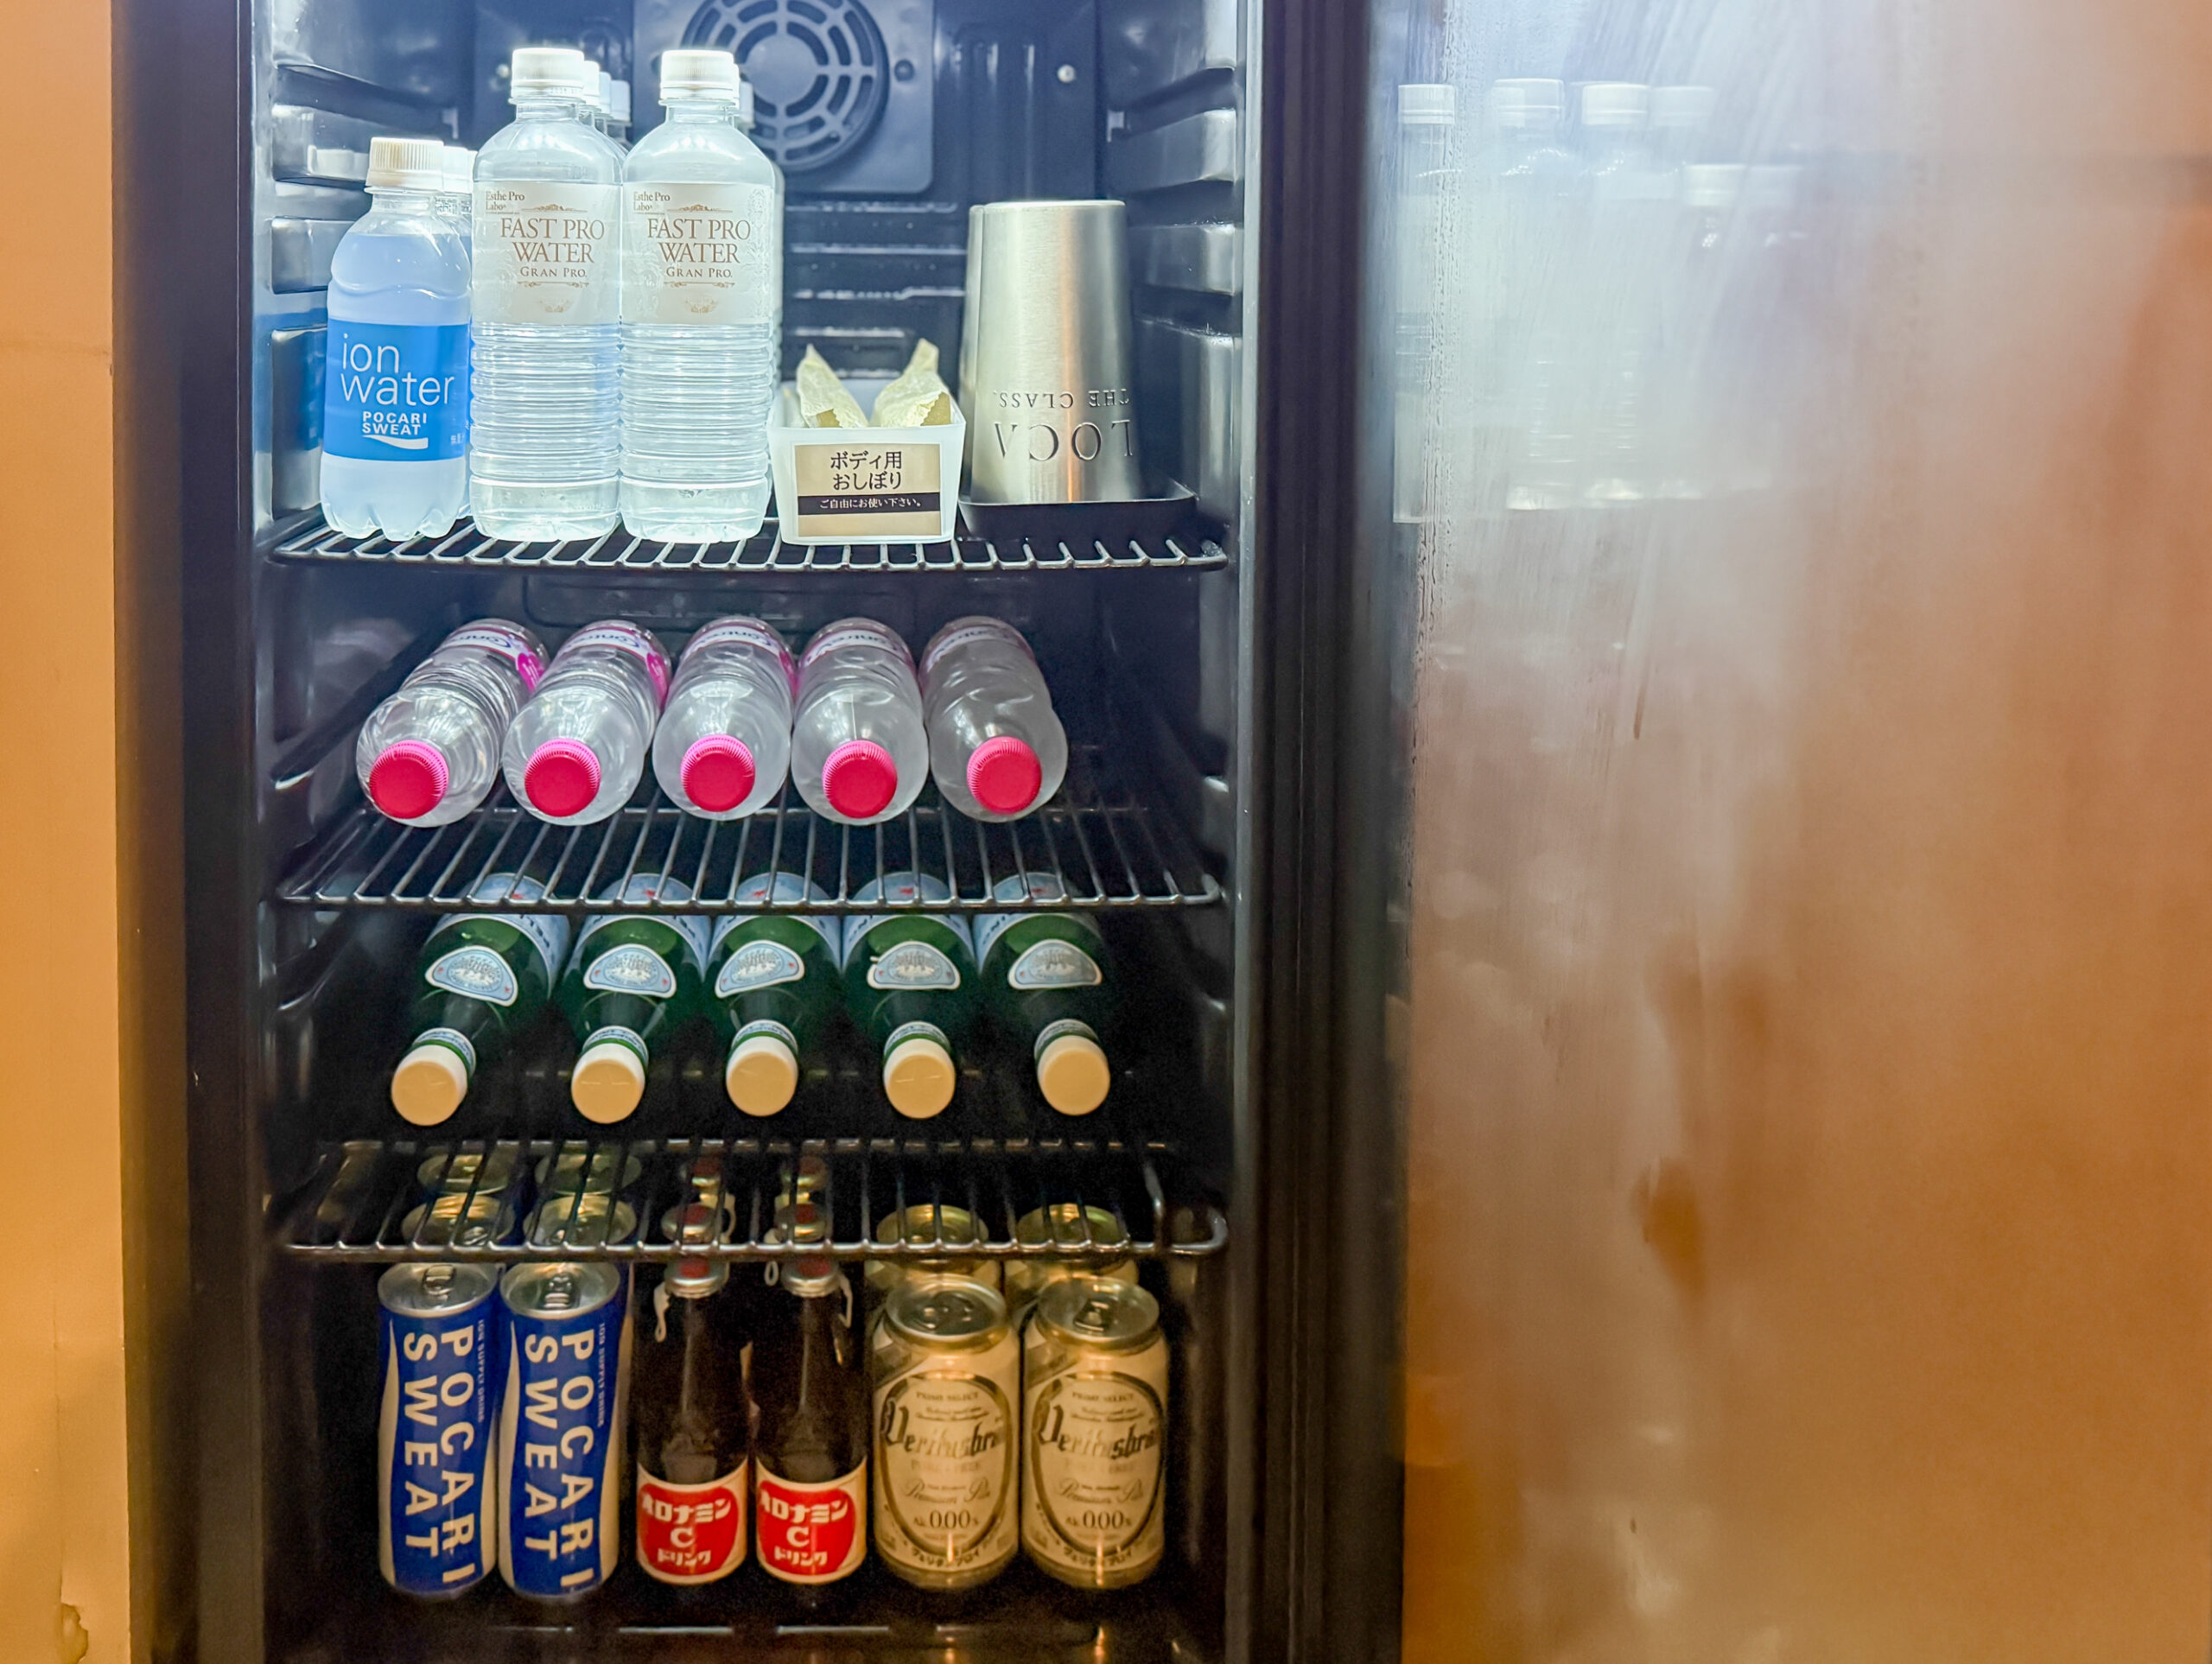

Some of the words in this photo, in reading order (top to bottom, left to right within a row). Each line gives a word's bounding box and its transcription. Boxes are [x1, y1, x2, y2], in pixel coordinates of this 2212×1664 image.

[486, 191, 507, 200] Esthe
[508, 191, 525, 201] Pro
[633, 191, 653, 201] Esthe
[654, 192, 671, 201] Pro
[499, 218, 557, 238] FAST
[563, 219, 605, 240] PRO
[647, 218, 702, 239] FAST
[708, 219, 751, 240] PRO
[512, 242, 594, 264] WATER
[658, 242, 741, 264] WATER
[342, 333, 400, 374] ion
[340, 372, 455, 406] water
[1087, 388, 1130, 407] THE
[362, 410, 428, 424] POCARI
[362, 422, 422, 435] SWEAT
[994, 420, 1134, 461] LOCA
[830, 451, 902, 470] ボディ用
[833, 471, 902, 491] おしぼり
[820, 497, 922, 509] ご自由にお使い下さい。
[404, 1332, 439, 1559] SWEAT
[441, 1325, 475, 1584] POCARI
[524, 1334, 558, 1560] SWEAT
[560, 1330, 594, 1587] POCARI
[671, 1527, 695, 1548] C
[786, 1526, 810, 1547] C
[658, 1547, 711, 1566] ドリンク
[774, 1546, 828, 1567] ドリンク
